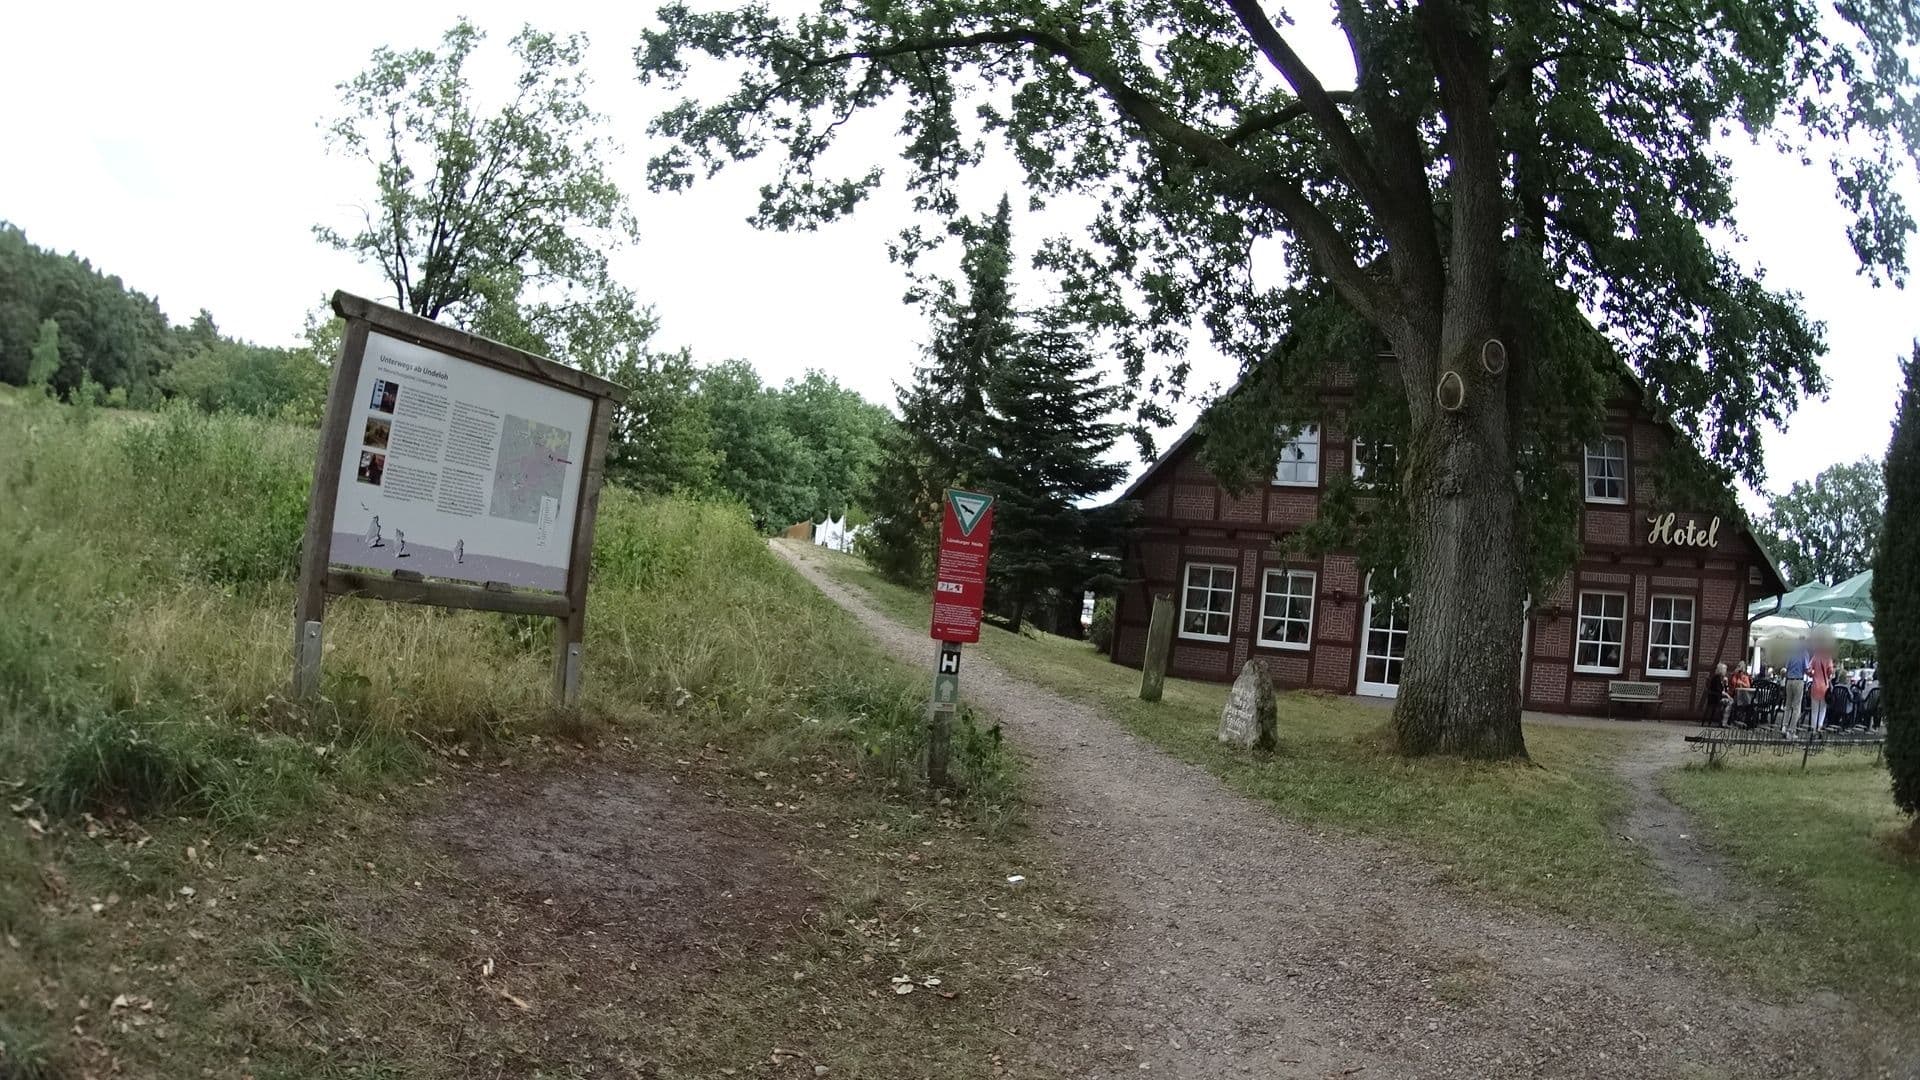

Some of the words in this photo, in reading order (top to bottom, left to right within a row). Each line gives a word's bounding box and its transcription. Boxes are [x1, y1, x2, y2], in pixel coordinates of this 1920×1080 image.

[380, 355, 413, 371] Unterwegs
[413, 365, 422, 373] ab
[423, 367, 449, 380] Undeloh
[1647, 512, 1720, 548] Hotel
[942, 653, 957, 673] H
